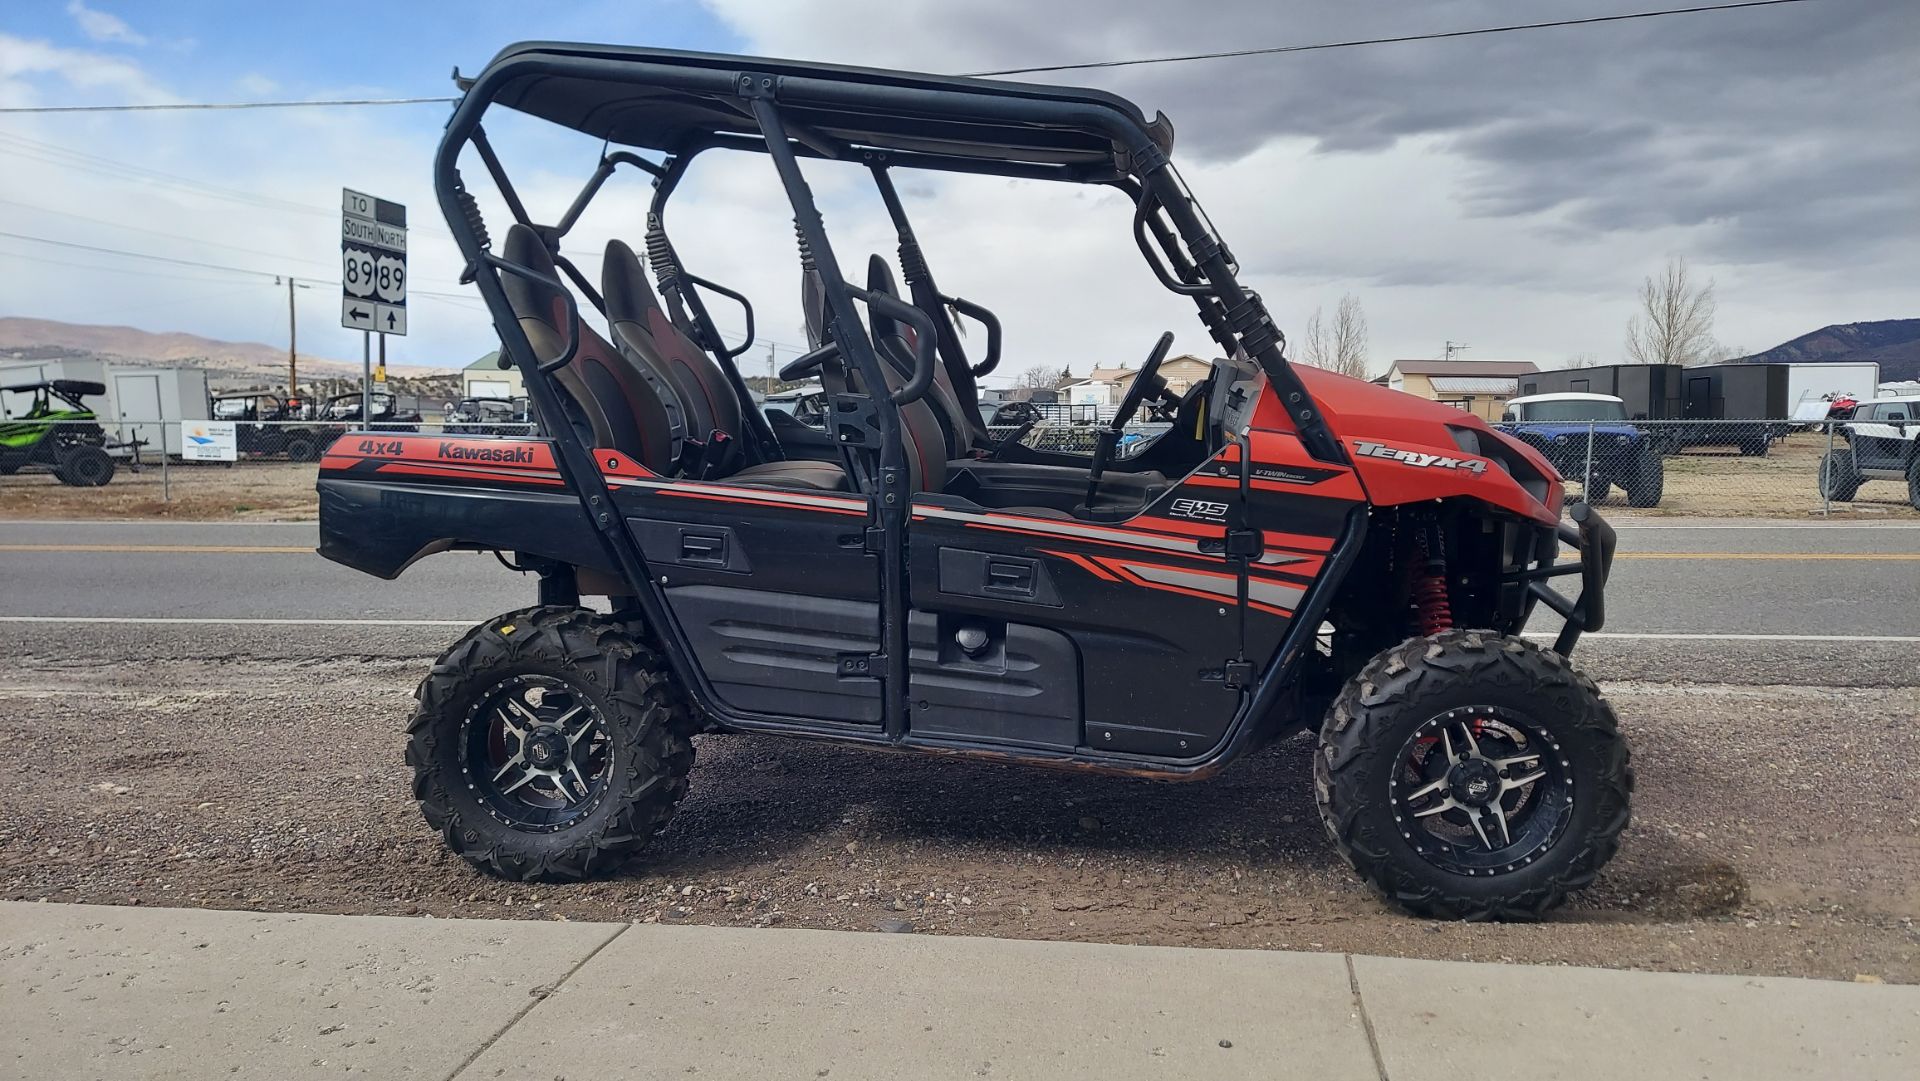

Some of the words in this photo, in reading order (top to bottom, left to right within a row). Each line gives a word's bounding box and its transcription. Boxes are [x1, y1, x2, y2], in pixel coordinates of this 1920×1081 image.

[352, 196, 367, 212] TO
[344, 219, 373, 240] SOUTH
[378, 228, 405, 247] NORTH
[346, 258, 373, 286] 89
[379, 265, 404, 292] 89
[358, 440, 404, 456] 4x4
[438, 441, 535, 463] Kawasaki
[1353, 440, 1488, 473] TERYX4
[1170, 498, 1229, 516] EPS
